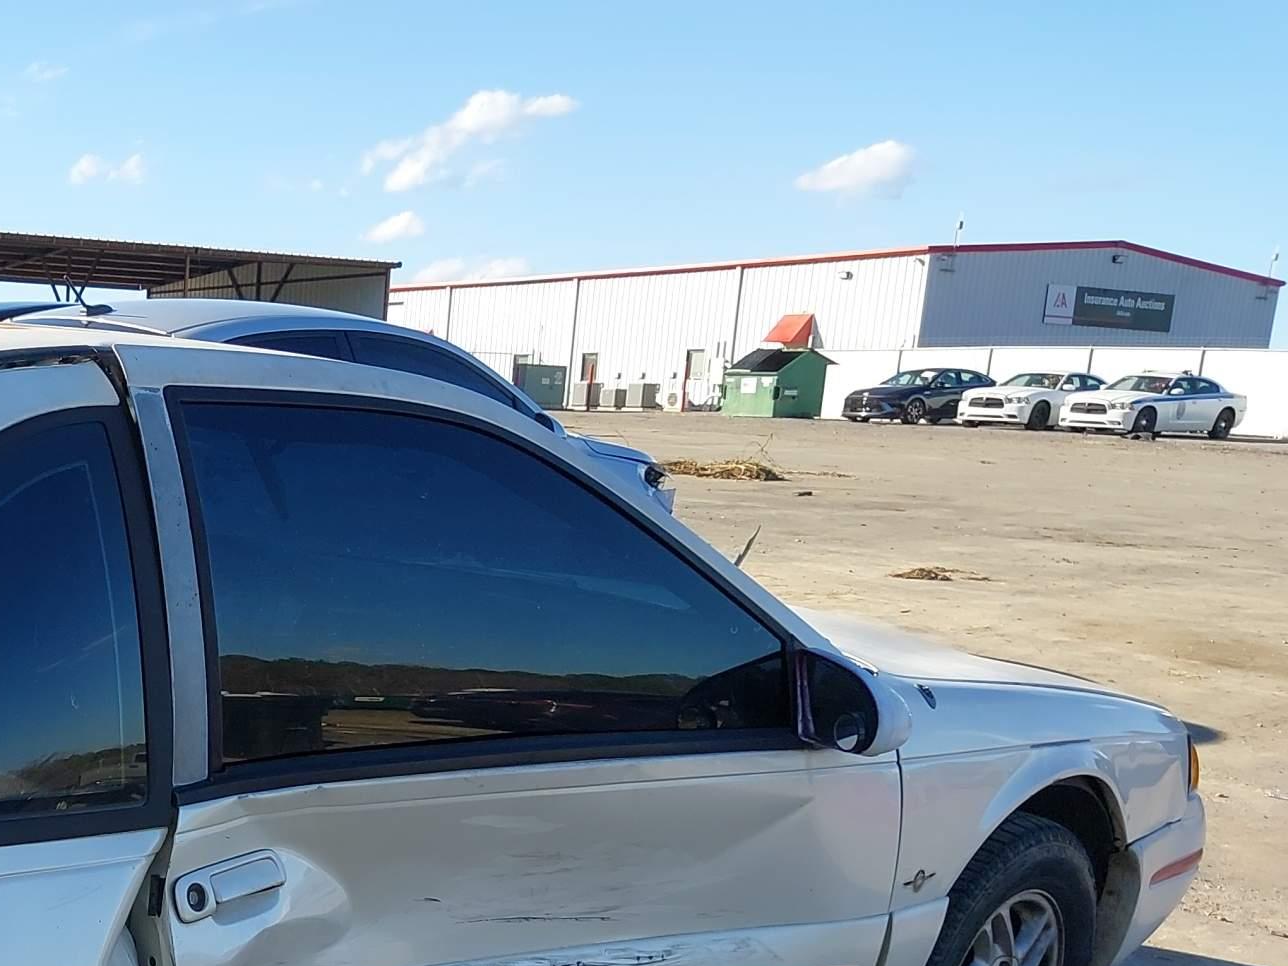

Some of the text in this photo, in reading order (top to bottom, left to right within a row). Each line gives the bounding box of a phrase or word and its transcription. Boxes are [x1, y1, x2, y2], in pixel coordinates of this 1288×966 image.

[1084, 293, 1165, 310] Insurance Auto Auctions
